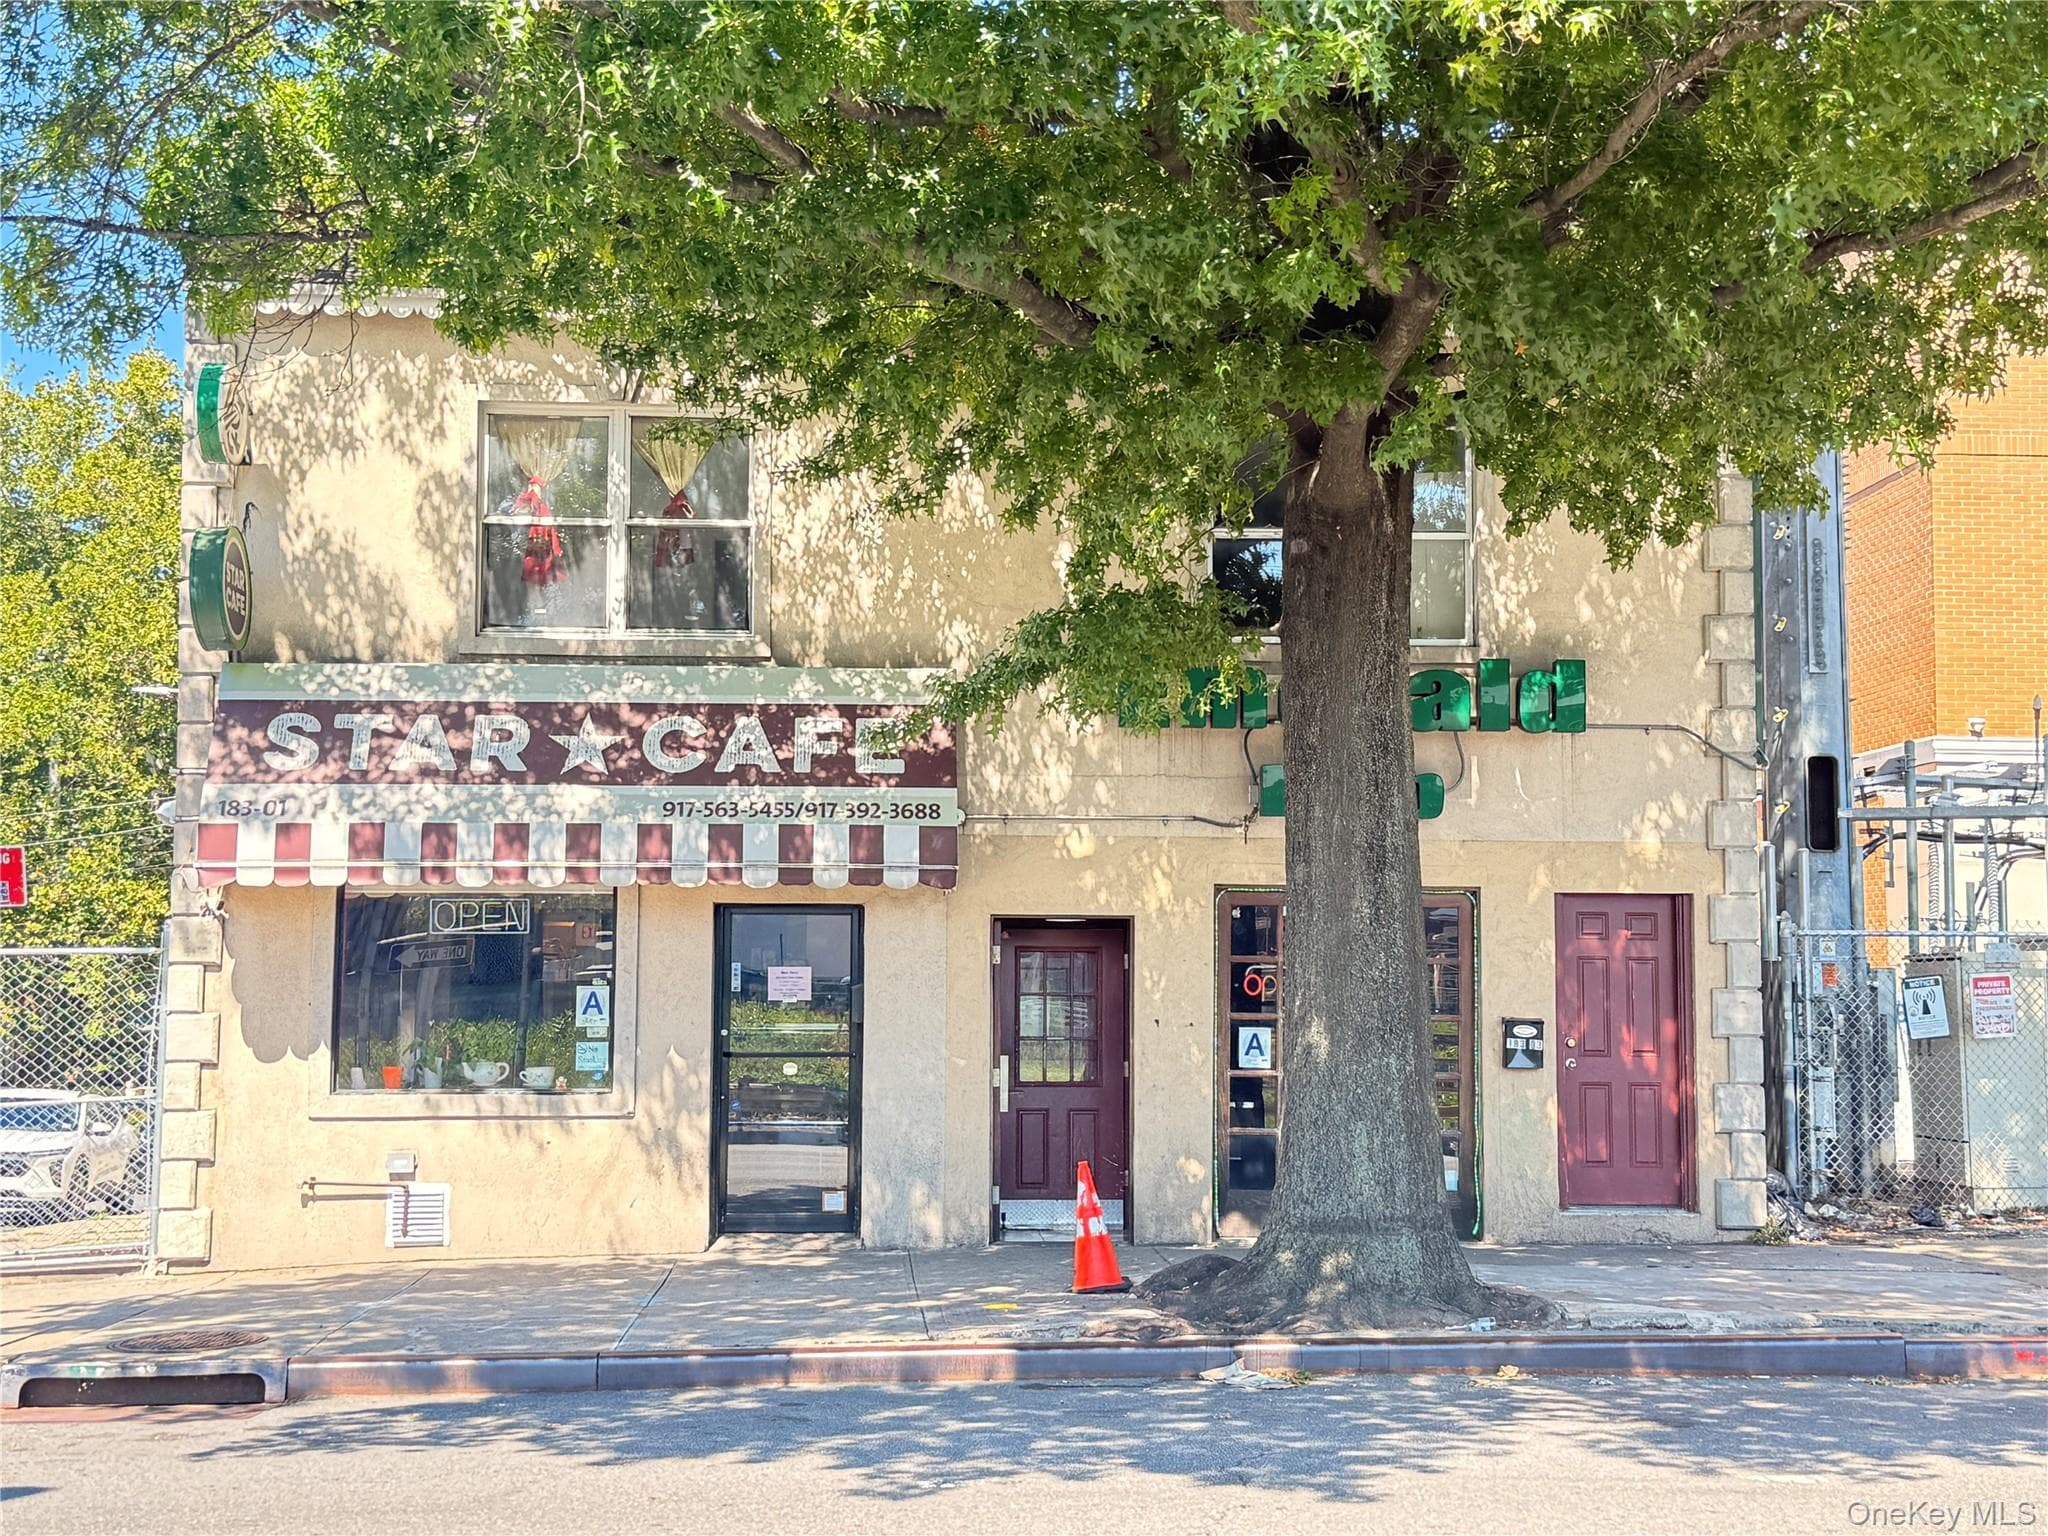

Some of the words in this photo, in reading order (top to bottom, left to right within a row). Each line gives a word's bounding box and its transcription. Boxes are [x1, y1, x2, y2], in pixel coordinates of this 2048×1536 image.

[226, 561, 245, 591] STAR
[226, 586, 246, 617] CAFE
[264, 711, 532, 773] STAR
[641, 714, 907, 775] CAFE
[218, 799, 288, 817] 183-01
[662, 801, 942, 820] 917-563-5455/917-392-3688
[434, 901, 527, 931] OPEN
[1974, 987, 2010, 995] PROPERTY
[1977, 980, 2006, 988] PRIVATE
[582, 991, 603, 1016] A
[1244, 1032, 1265, 1057] A
